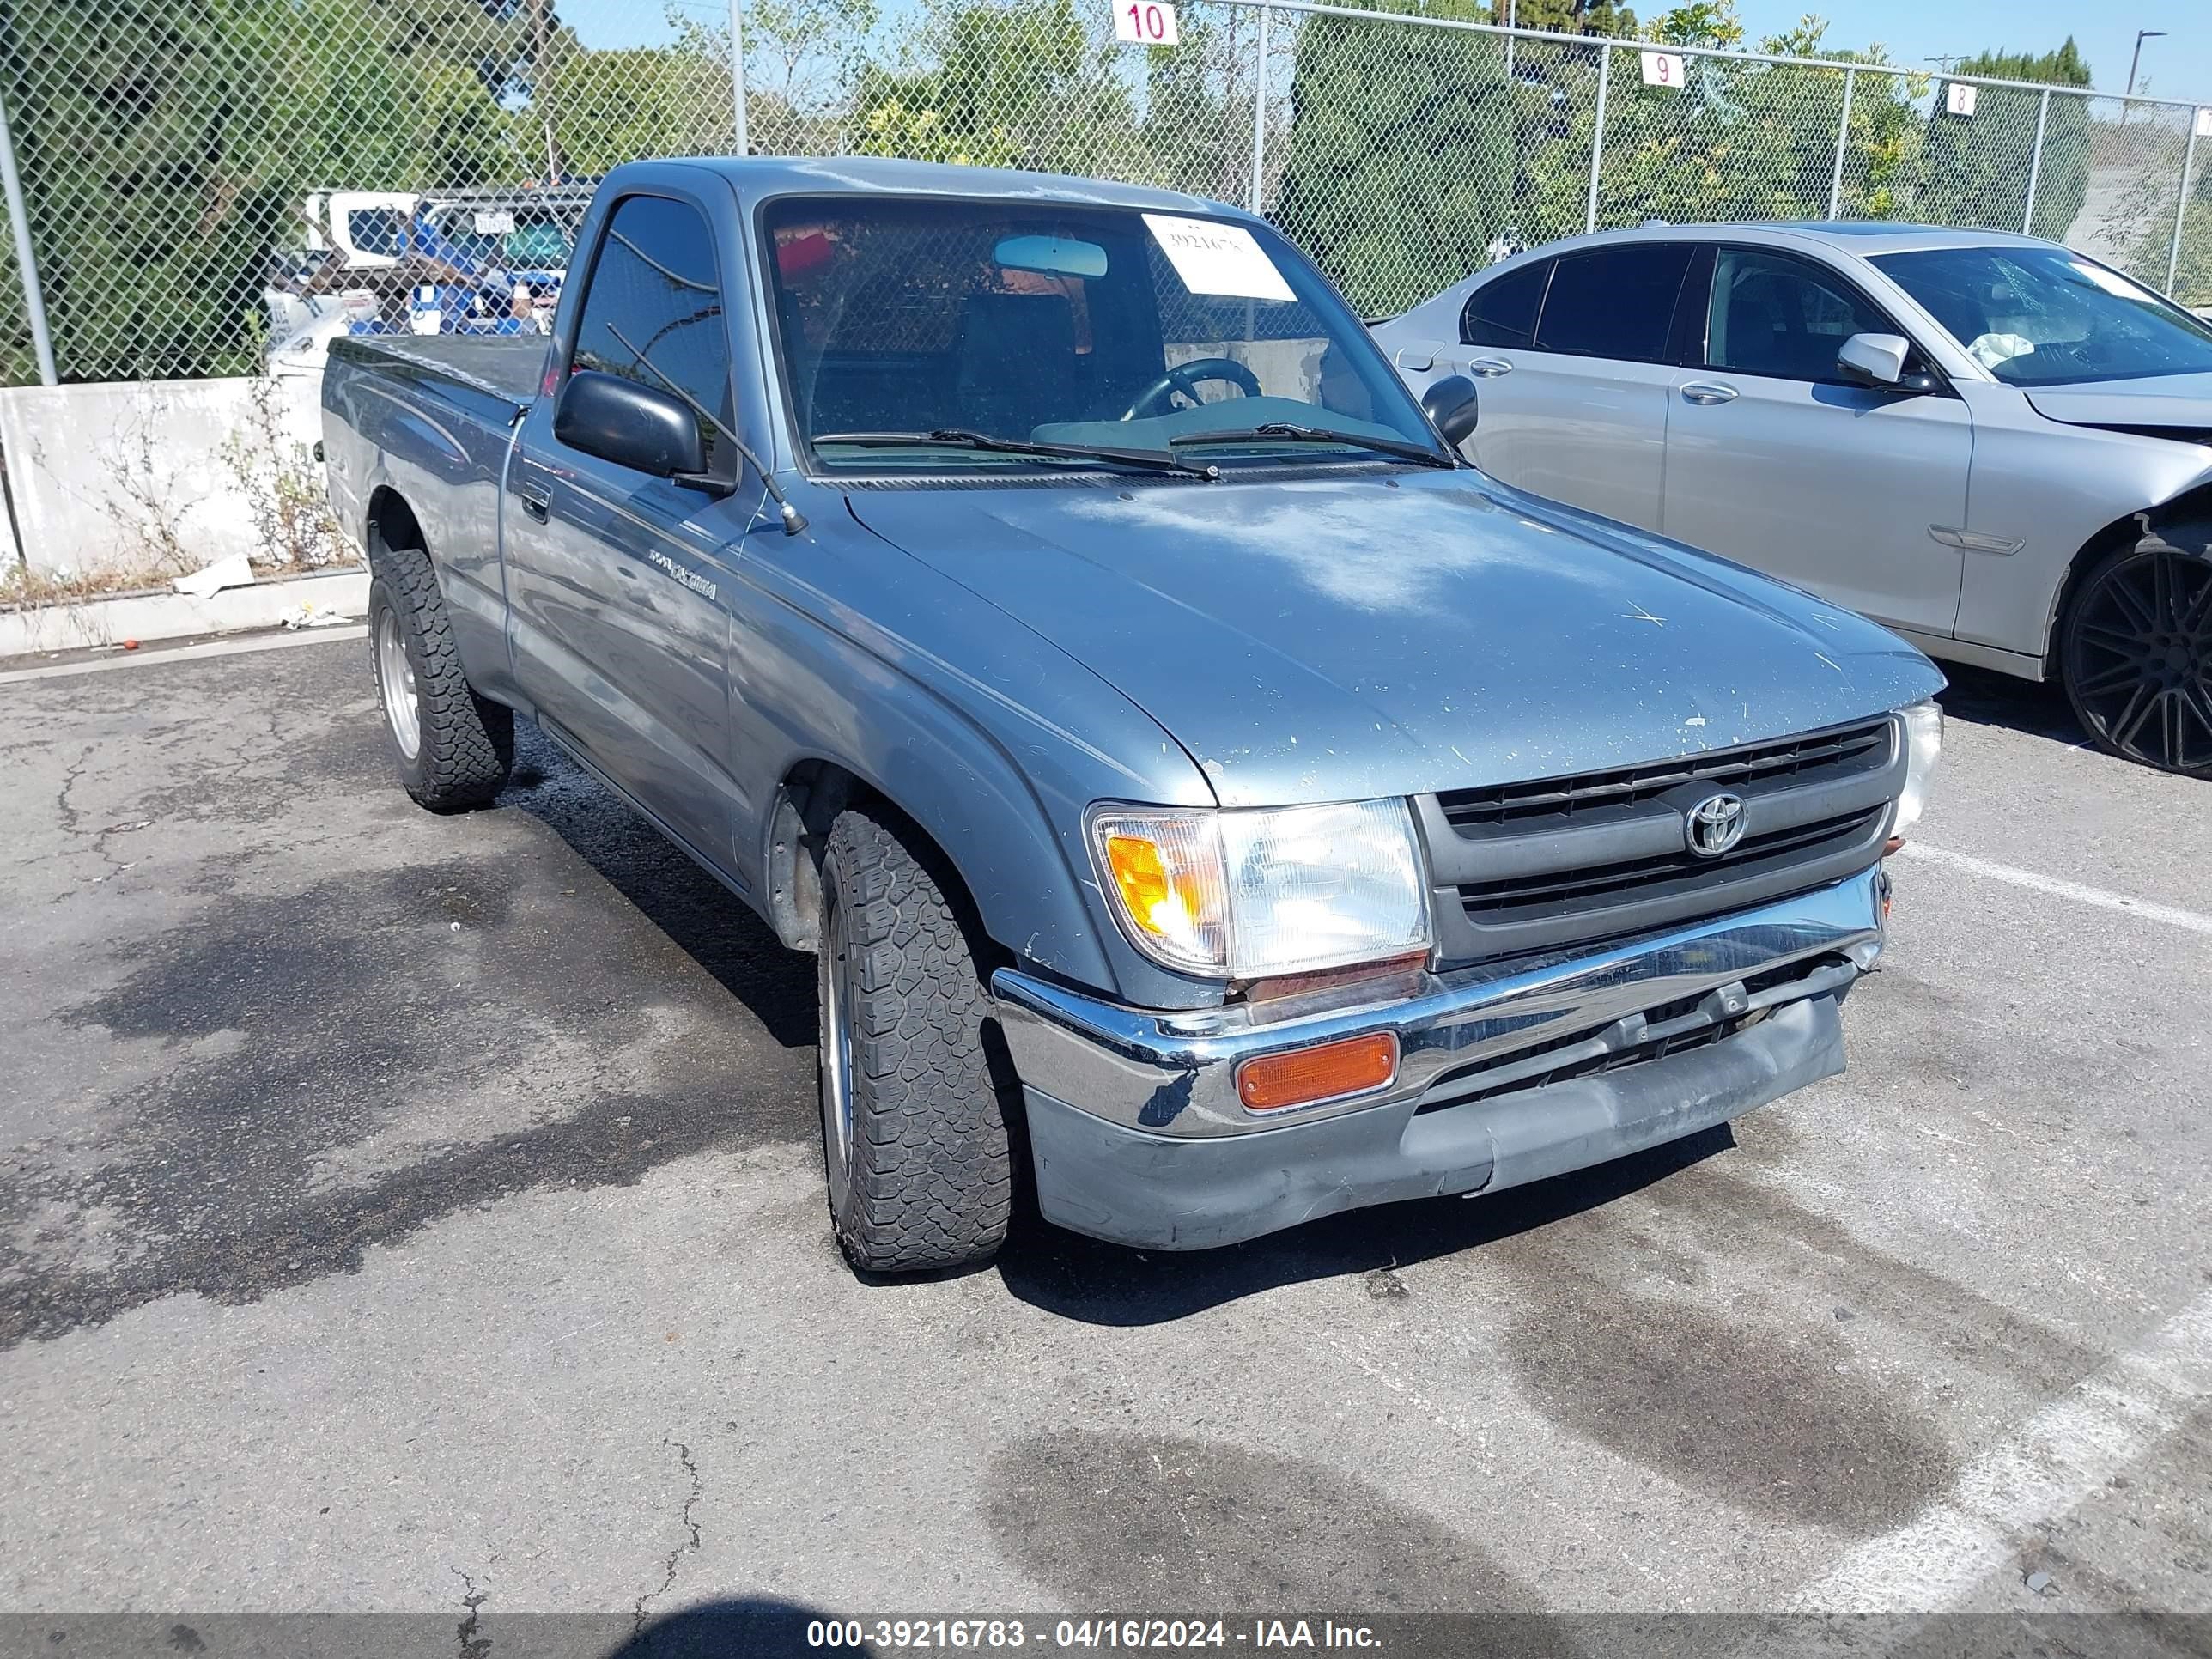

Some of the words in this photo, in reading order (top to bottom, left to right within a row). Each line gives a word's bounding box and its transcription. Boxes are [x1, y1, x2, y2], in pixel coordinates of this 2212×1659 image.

[1127, 3, 1164, 40] 10
[1657, 56, 1669, 83] 9
[1958, 88, 1966, 112] 8
